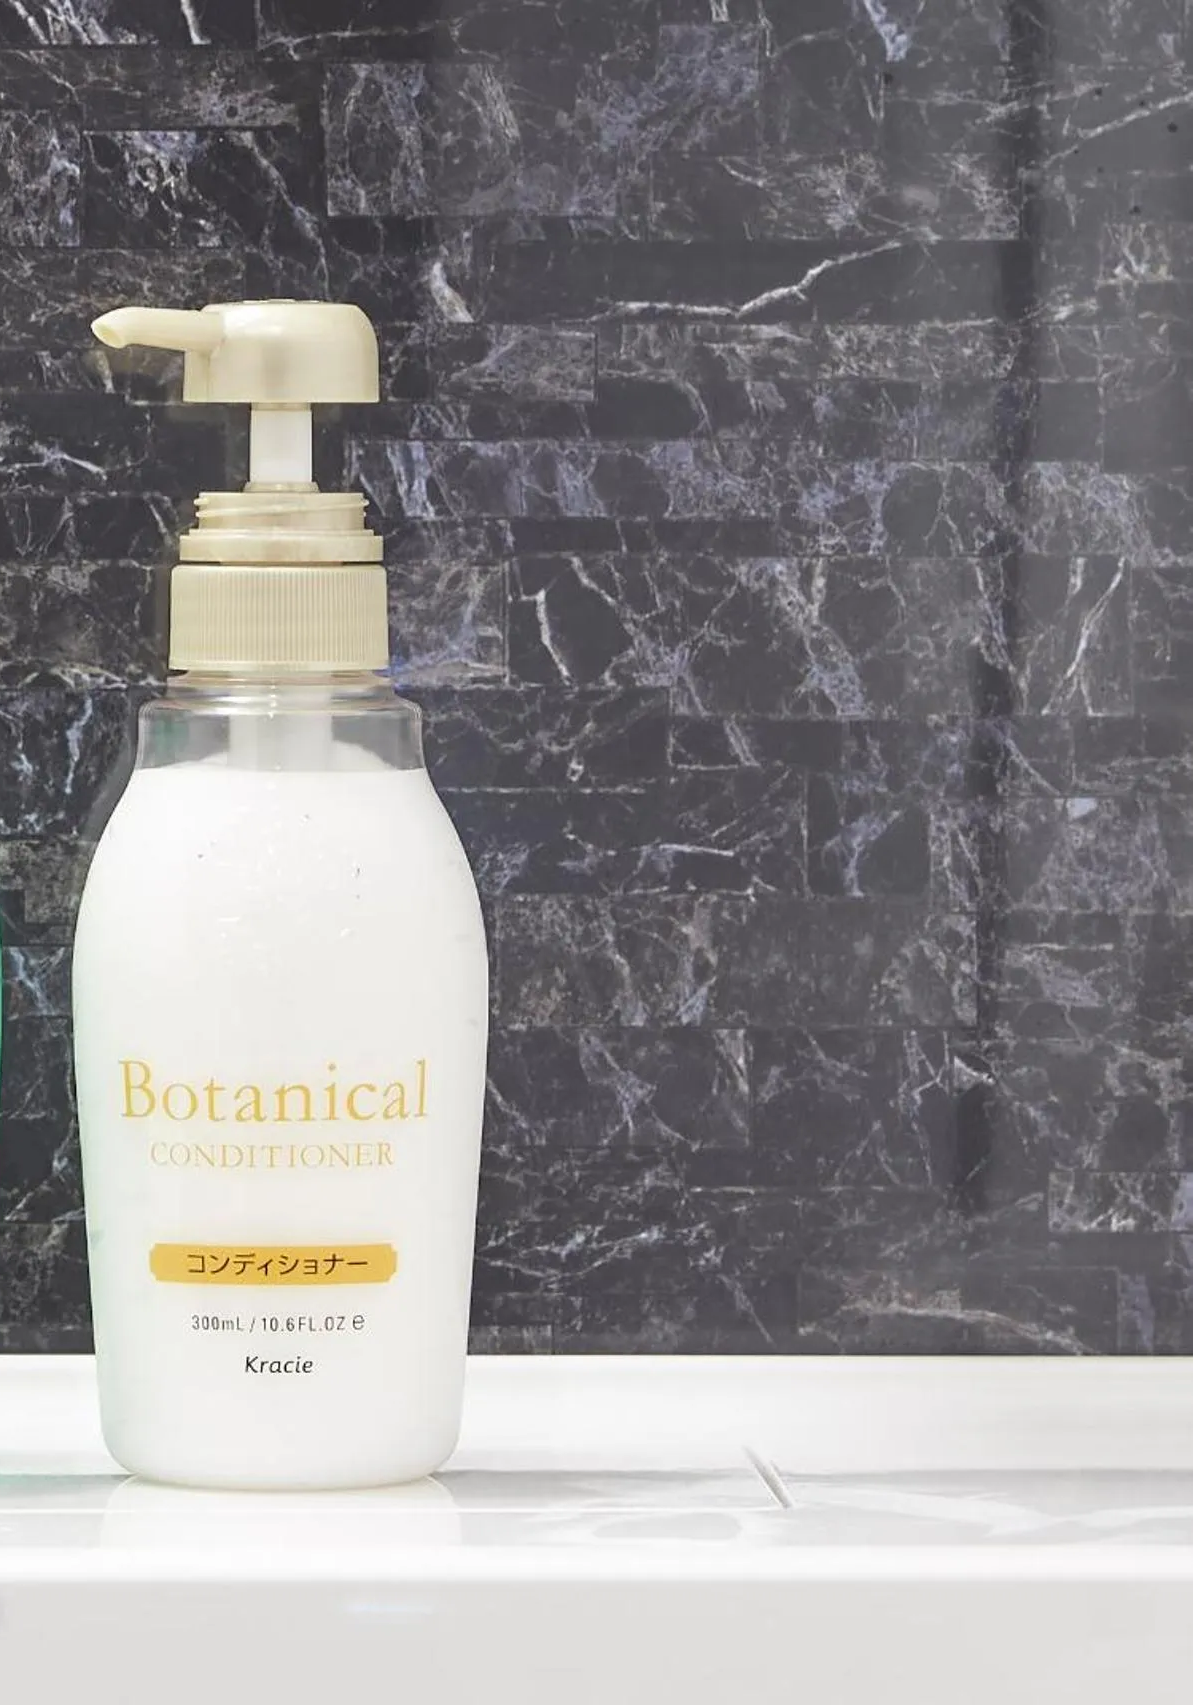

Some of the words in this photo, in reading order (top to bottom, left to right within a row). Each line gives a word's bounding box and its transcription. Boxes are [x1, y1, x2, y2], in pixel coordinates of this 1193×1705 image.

[118, 1058, 429, 1123] Botanical
[150, 1141, 395, 1168] CONDITIONER
[187, 1252, 369, 1276] コンディショナー
[191, 1314, 245, 1332] 300mL
[244, 1355, 314, 1375] Kracie
